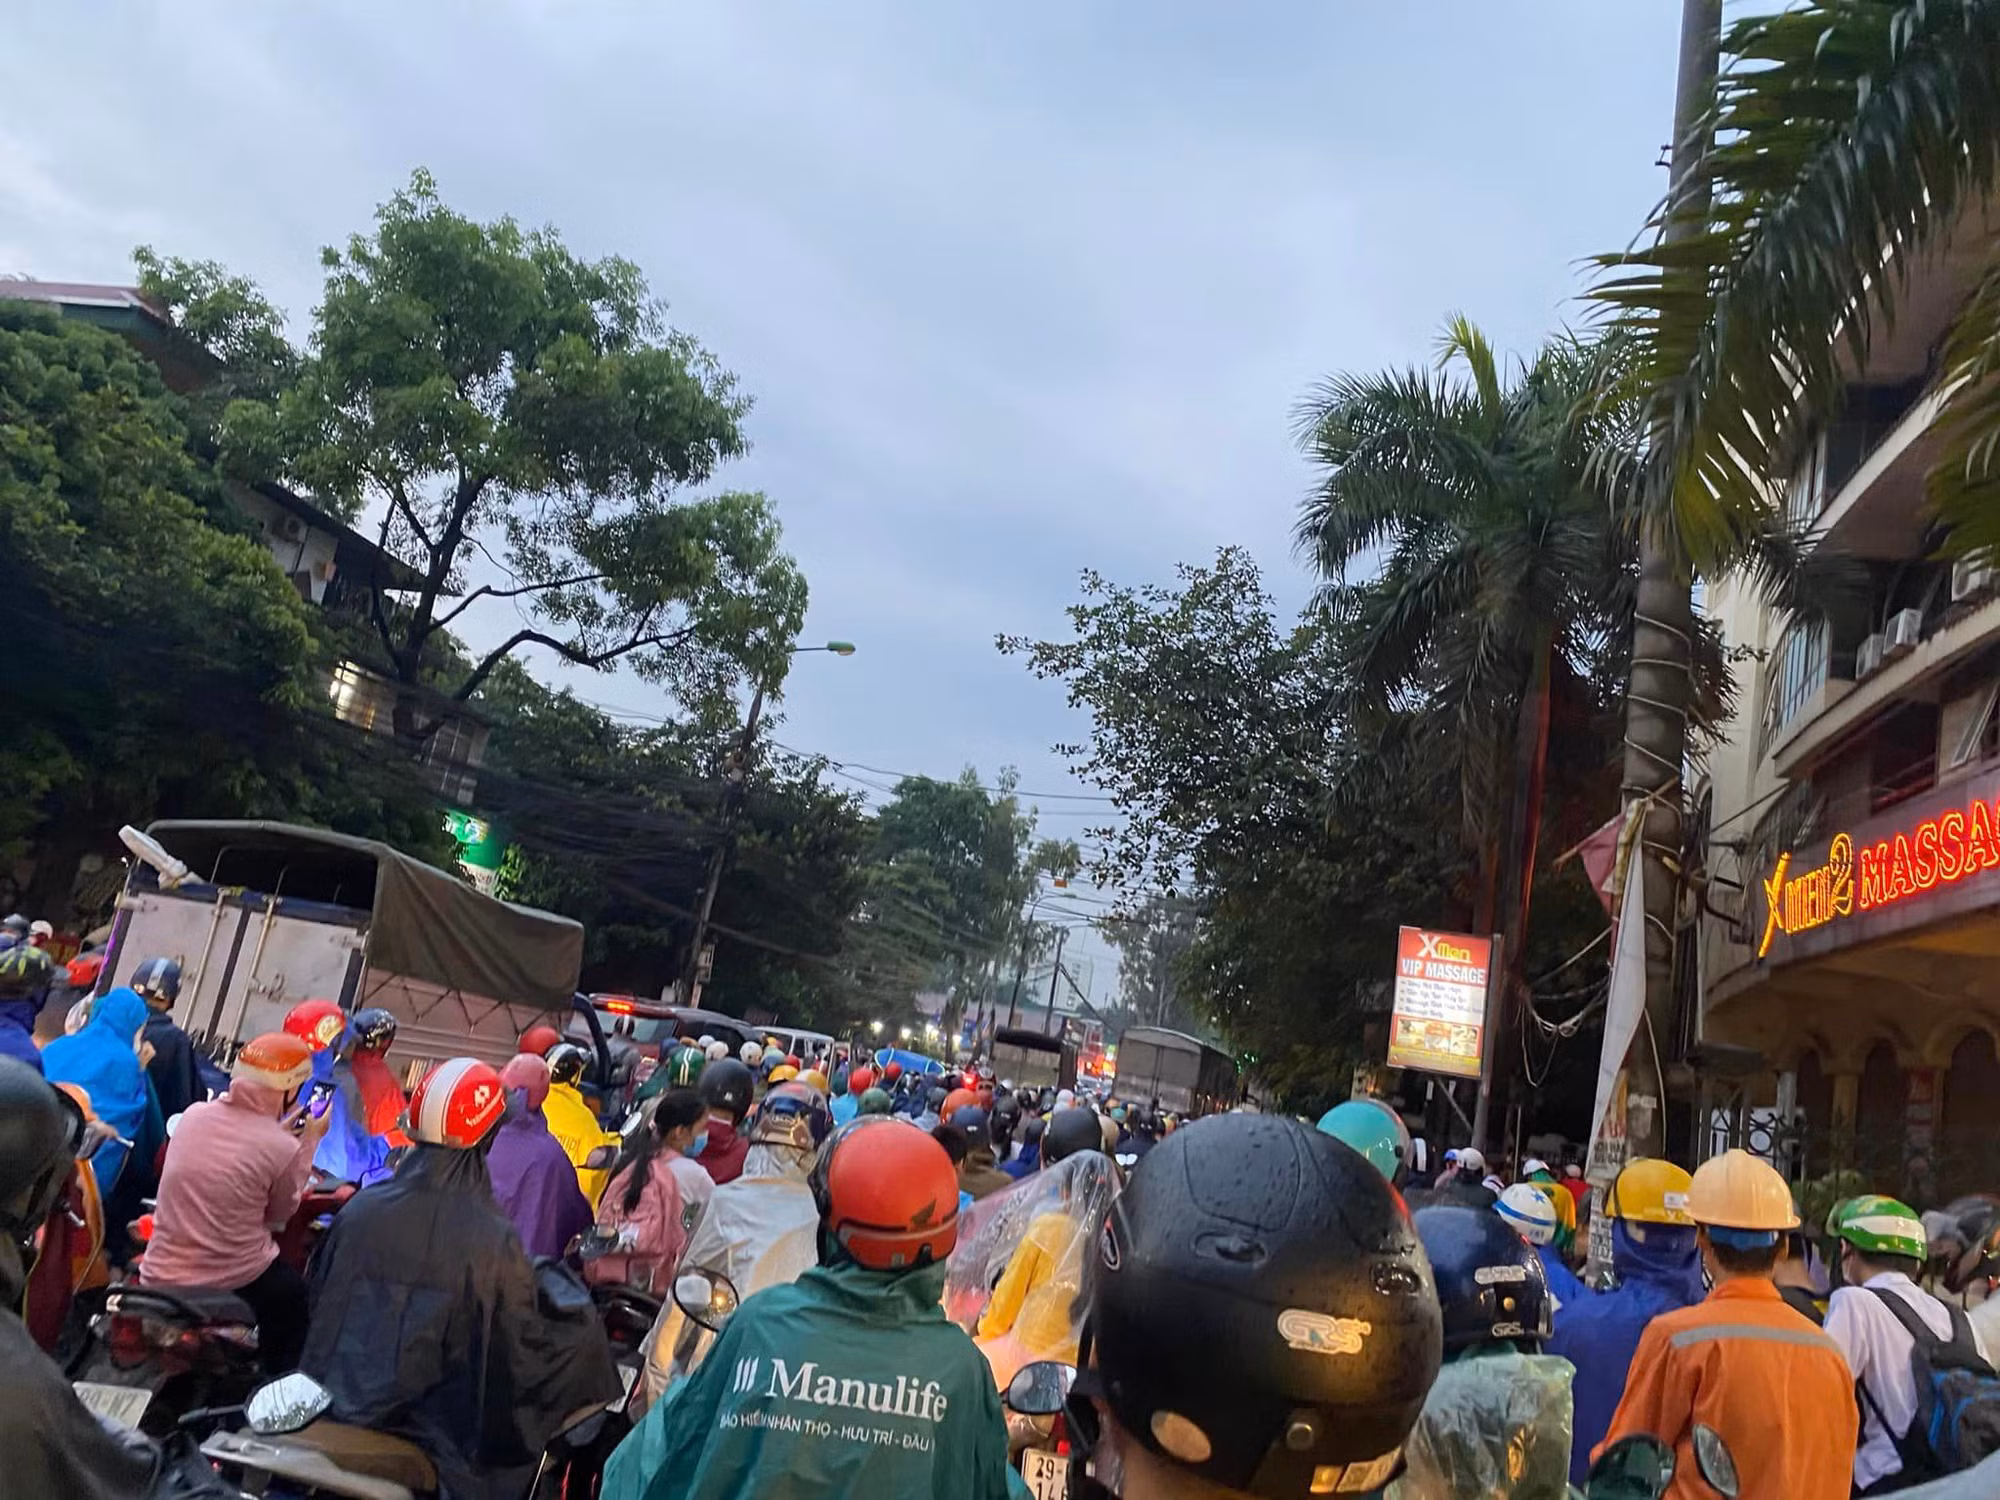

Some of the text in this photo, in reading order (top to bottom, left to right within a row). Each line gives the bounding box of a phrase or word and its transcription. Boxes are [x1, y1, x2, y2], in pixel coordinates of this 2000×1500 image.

[1859, 800, 2000, 909] MASSA
[1401, 958, 1486, 985] VIP MASSAGE
[765, 1358, 948, 1422] Manulife
[805, 1420, 831, 1438] THỌ
[873, 1428, 893, 1446] TRÍ
